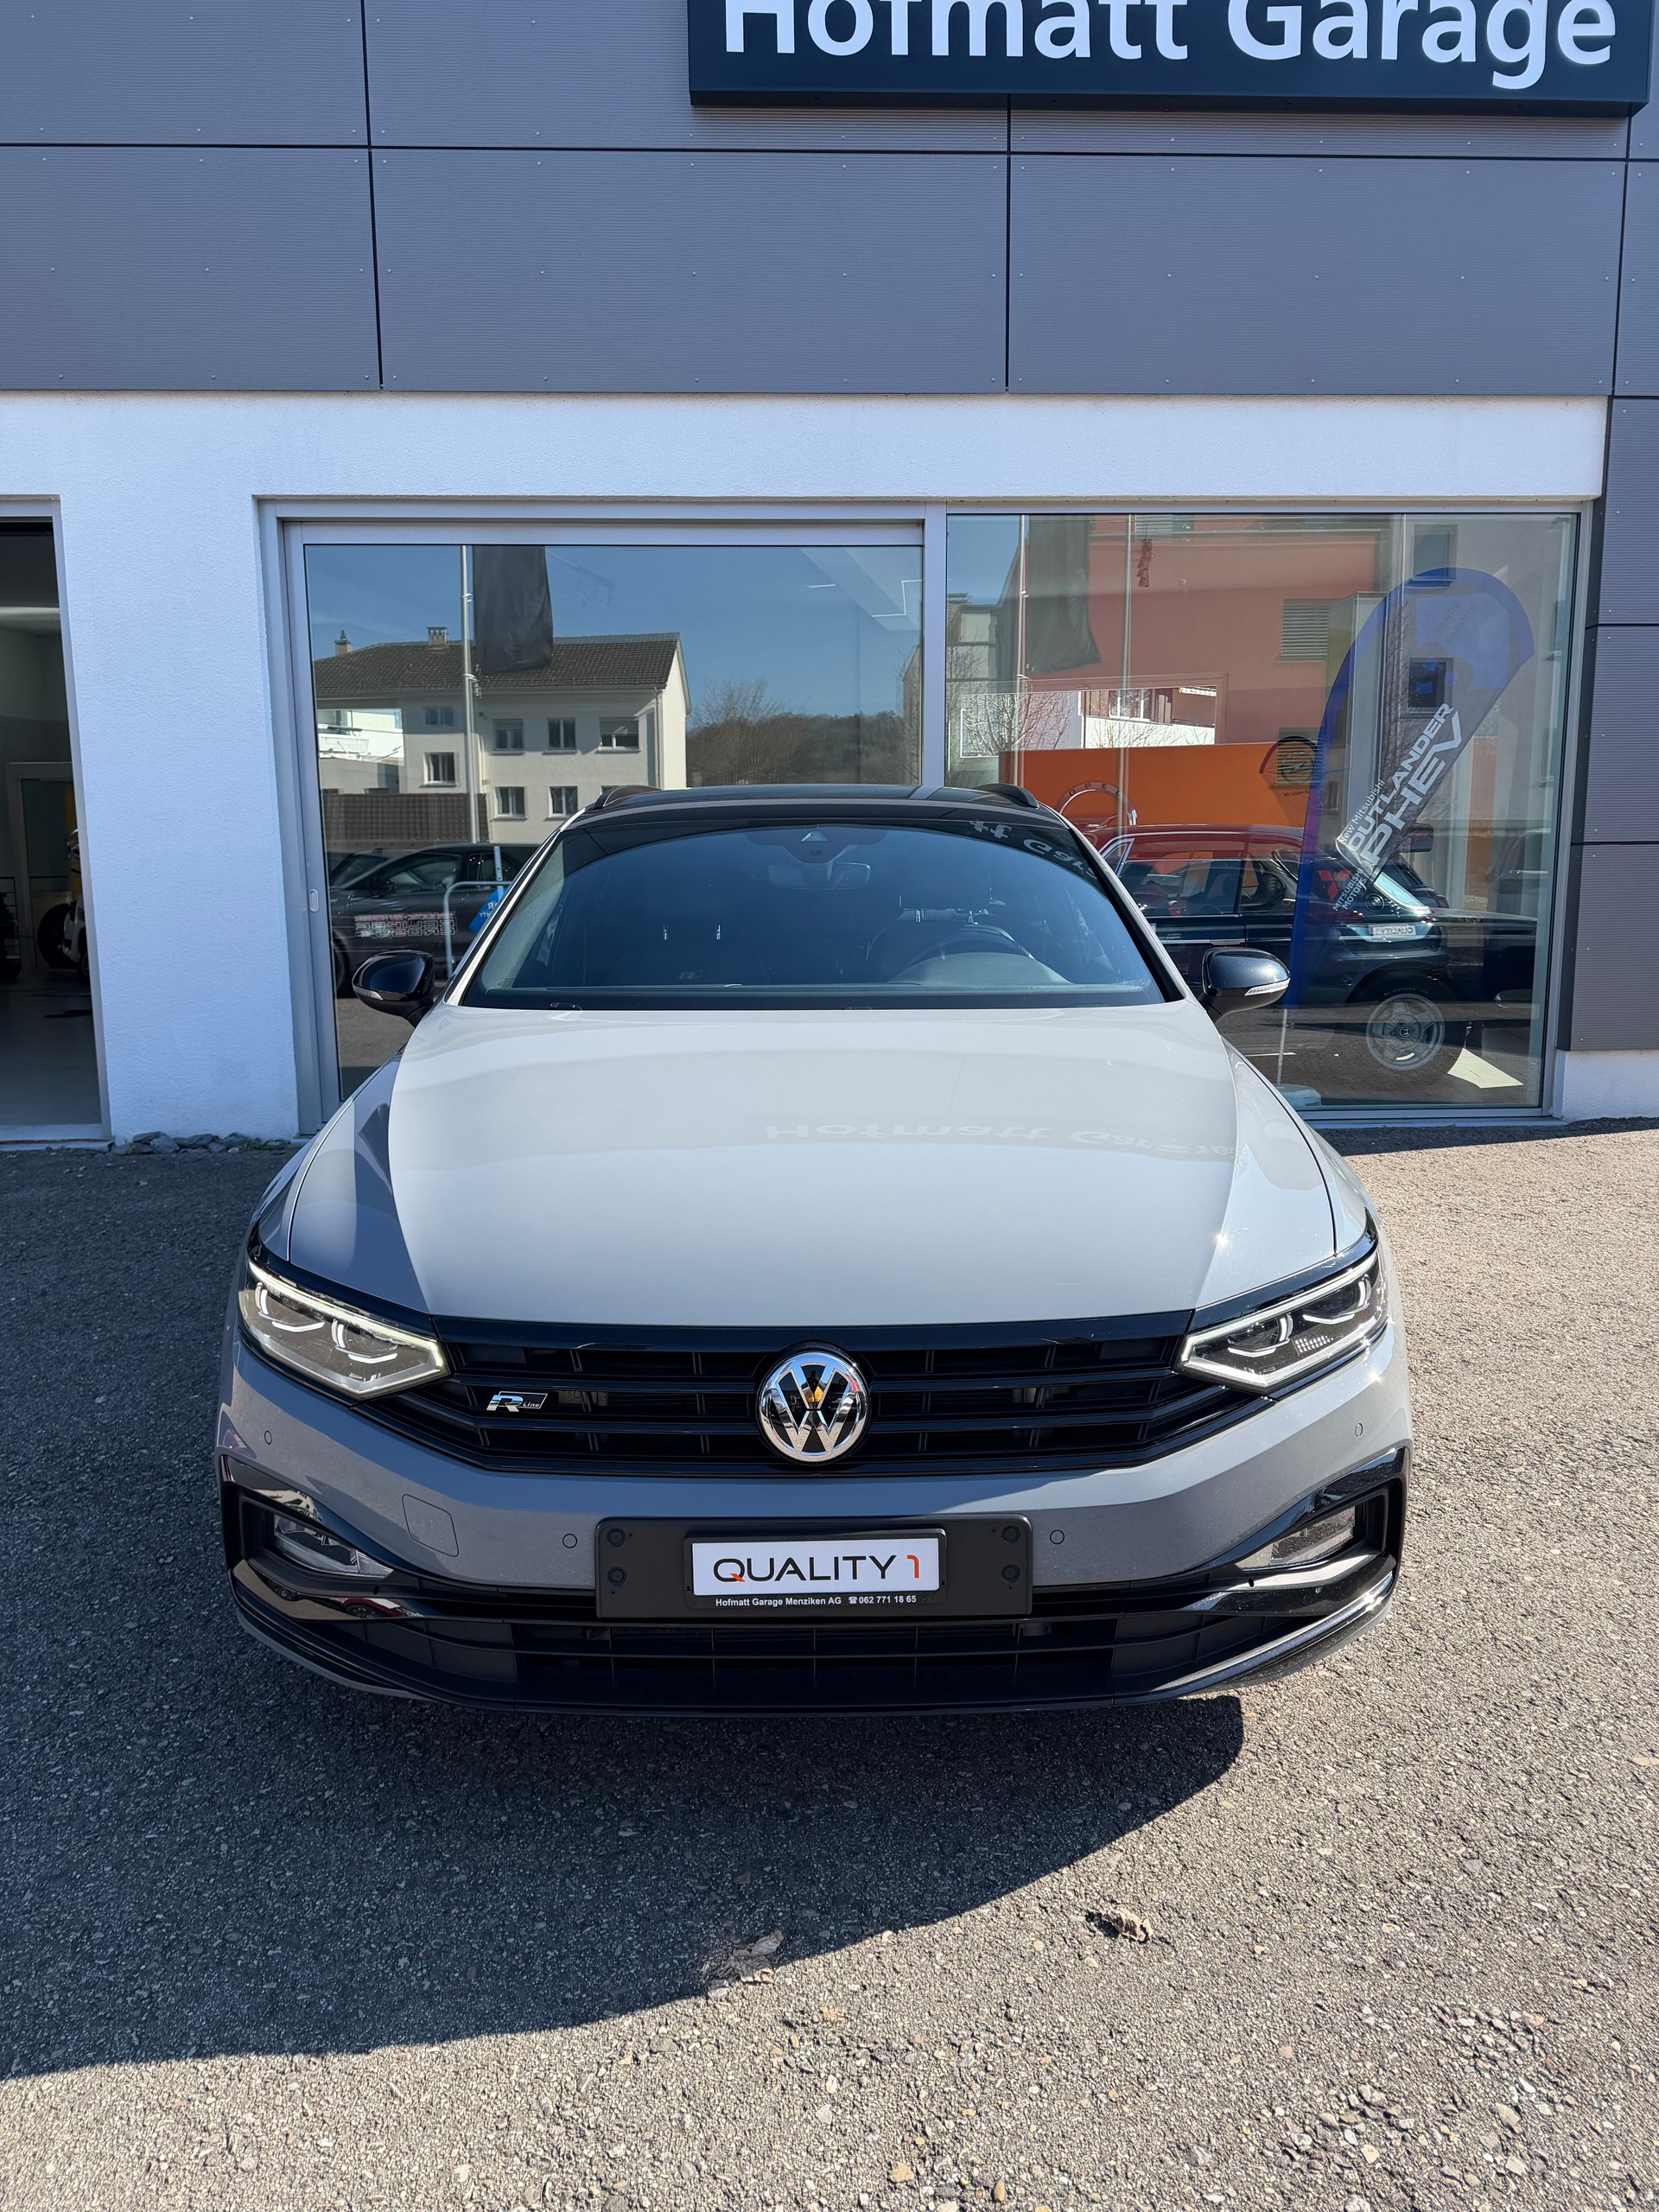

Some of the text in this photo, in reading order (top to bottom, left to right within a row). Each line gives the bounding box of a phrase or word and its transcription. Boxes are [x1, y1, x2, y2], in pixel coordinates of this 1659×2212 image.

[726, 0, 1616, 89] Hofmatt Garage
[1348, 702, 1454, 852] OUTLANDER
[1360, 710, 1462, 867] PHEV
[1338, 779, 1385, 845] New Mitsubishi
[1332, 868, 1364, 911] MITSUBISHI
[713, 1554, 919, 1582] QUALITY 1
[752, 1598, 783, 1607] Garage
[785, 1597, 826, 1605] Menziken
